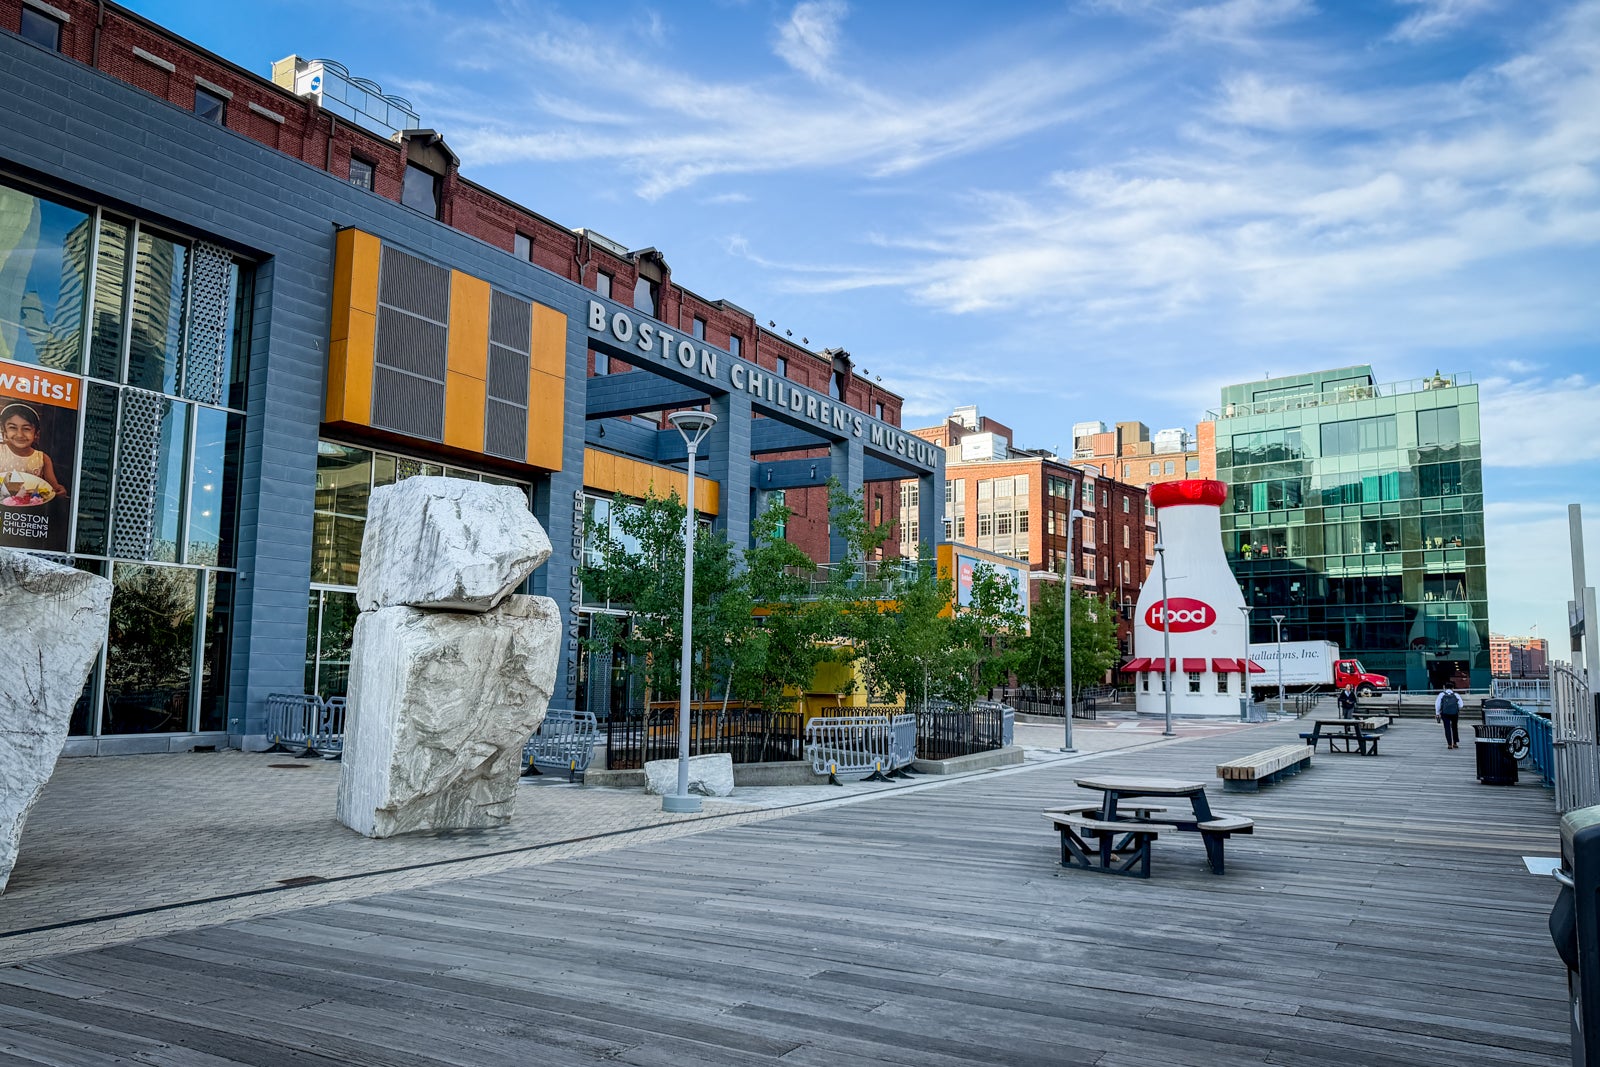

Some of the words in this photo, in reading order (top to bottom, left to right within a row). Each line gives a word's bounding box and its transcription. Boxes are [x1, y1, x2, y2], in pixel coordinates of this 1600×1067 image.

[0, 373, 72, 402] waits!
[588, 299, 717, 379] BOSTON
[730, 363, 863, 438] CHILDREN'S
[870, 423, 938, 468] MUSEUM
[3, 520, 49, 531] CHILDREN'S
[4, 511, 49, 524] BOSTON
[571, 489, 583, 561] CENTER
[2, 526, 48, 539] MUSEUM
[568, 565, 580, 651] BALANCE
[1152, 606, 1206, 624] Hood
[1249, 650, 1299, 661] tallations,
[1301, 649, 1319, 659] Inc.
[566, 657, 577, 700] NEW
